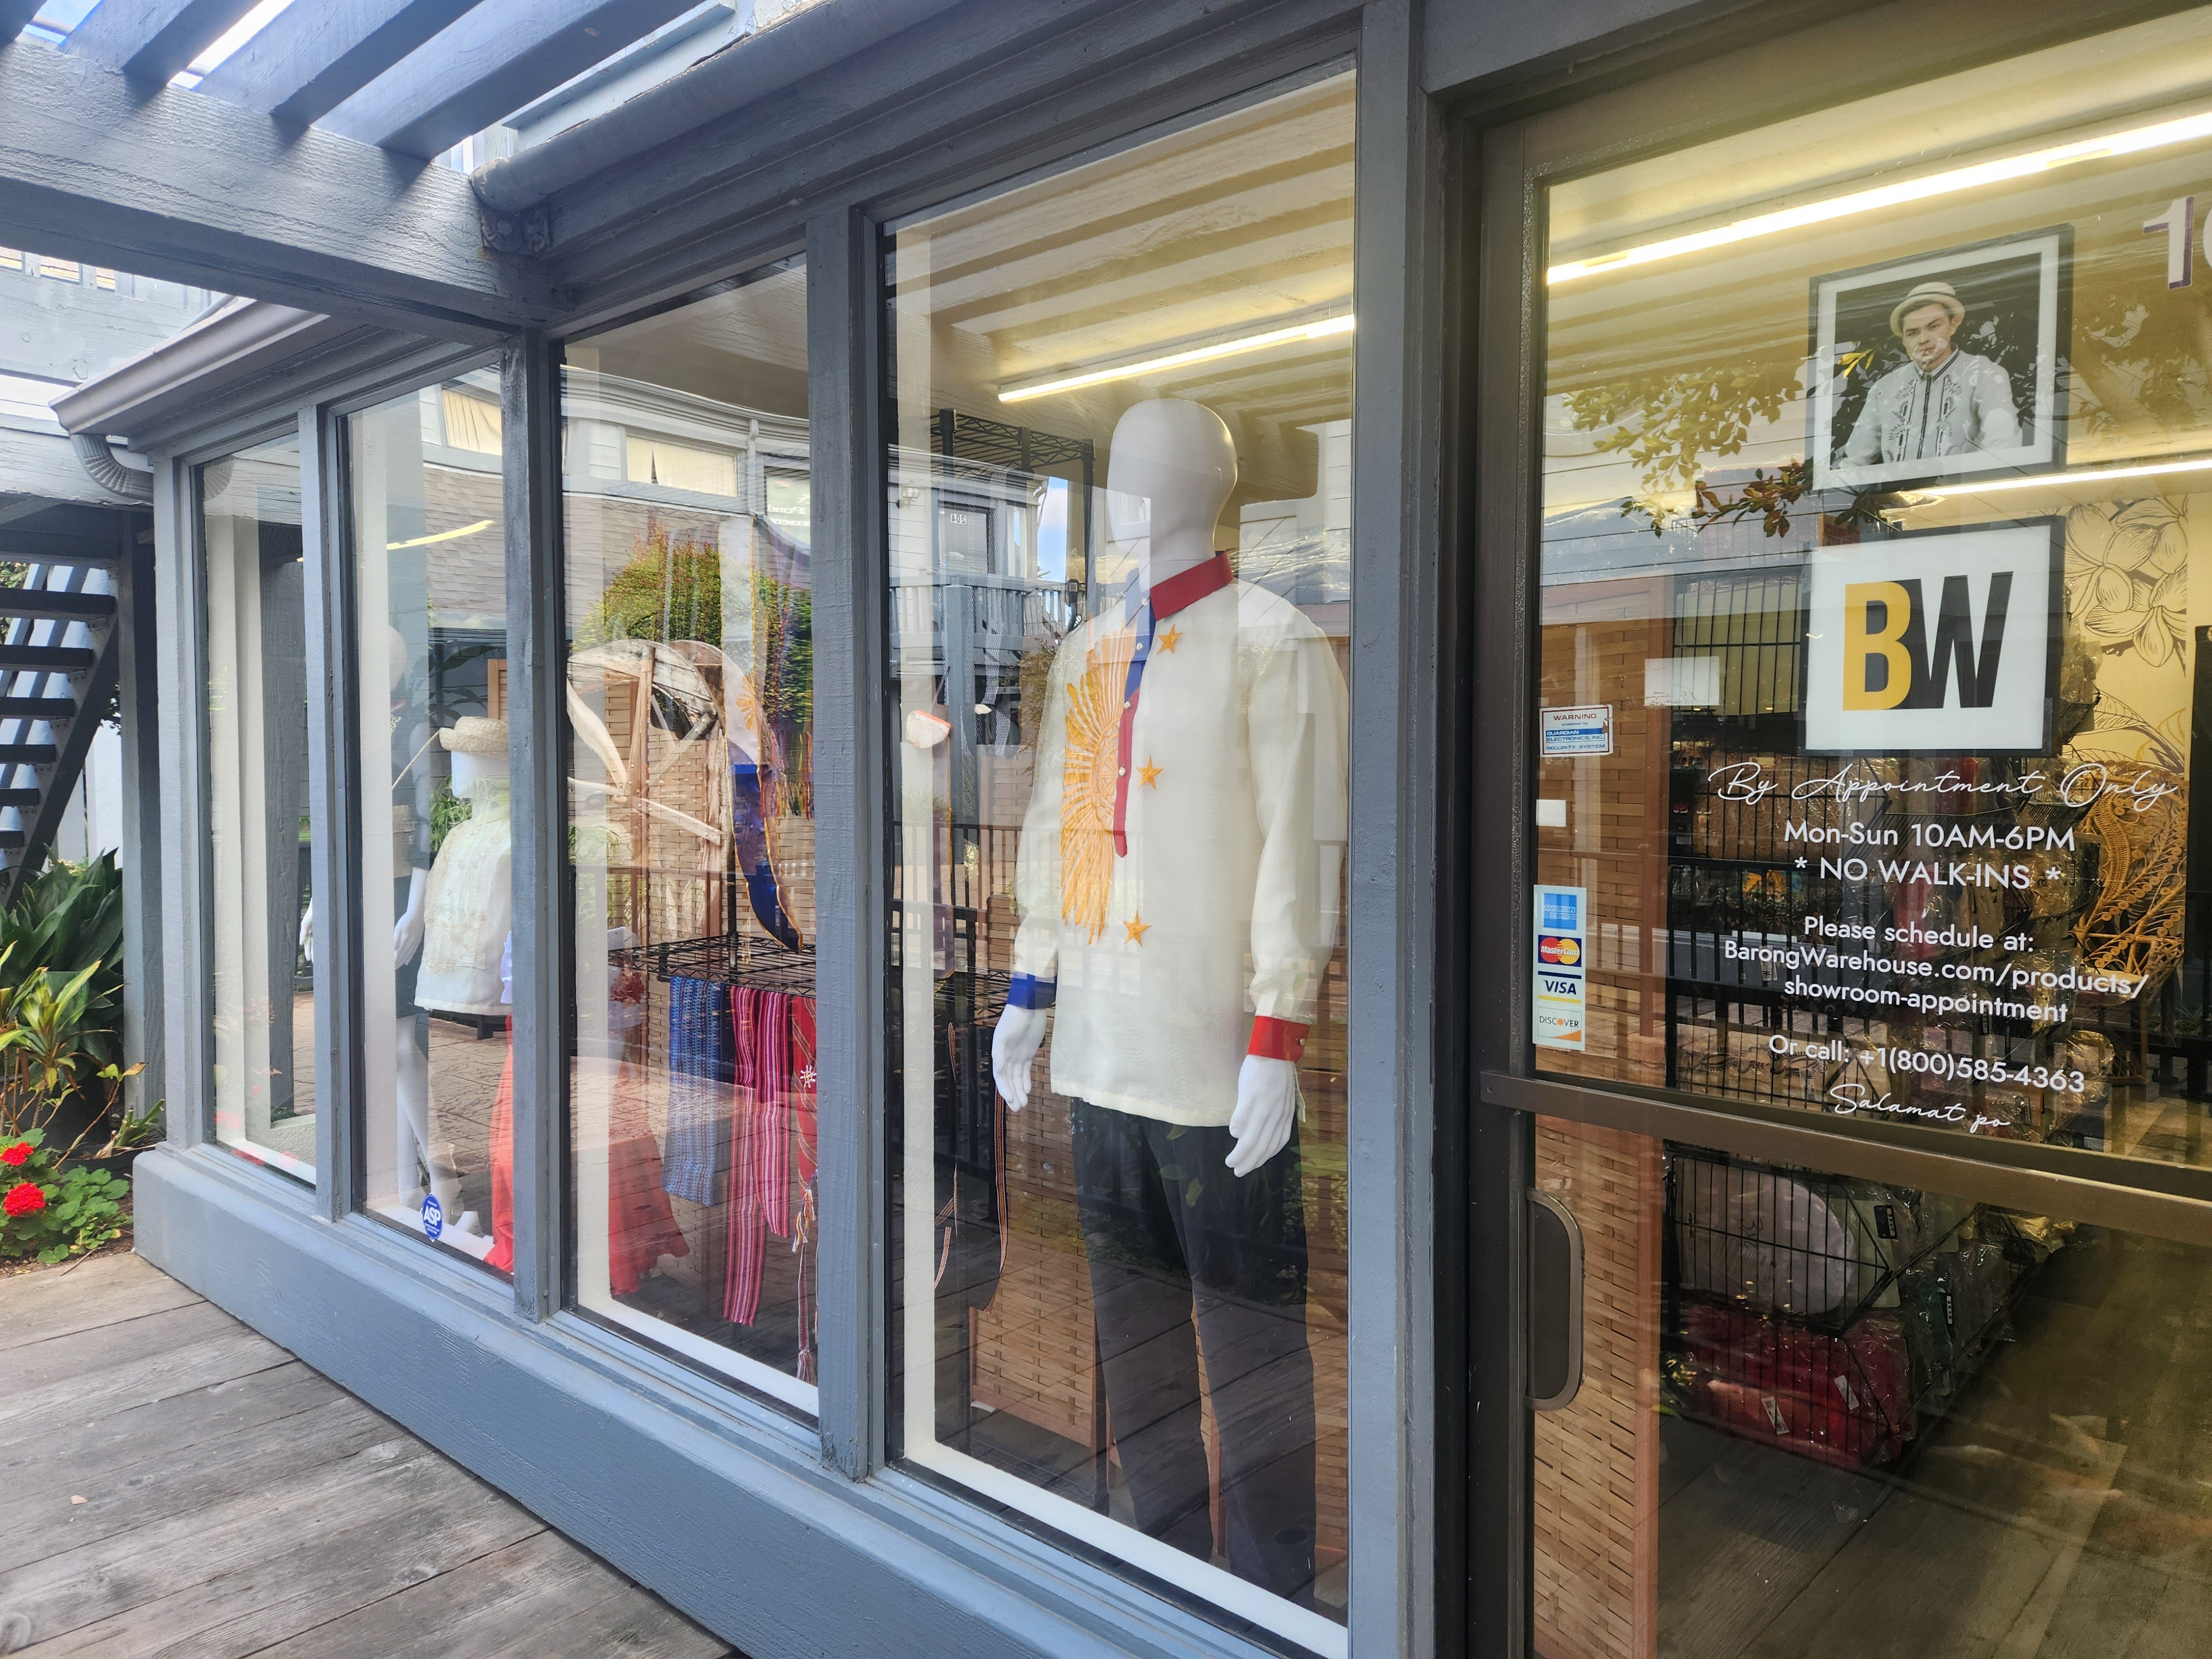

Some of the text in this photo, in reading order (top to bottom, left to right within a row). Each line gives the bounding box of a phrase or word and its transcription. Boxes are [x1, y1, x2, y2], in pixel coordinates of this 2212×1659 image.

[2143, 196, 2212, 290] 1
[1843, 571, 2013, 712] BW
[1708, 762, 1778, 805] By
[1791, 763, 2046, 803] Appointment
[2060, 763, 2178, 812] Only
[1784, 820, 2075, 852] Mon-Sun 10AM-6PM
[1820, 857, 1868, 881] NO
[1877, 859, 2029, 890] WALK-INS
[1540, 946, 1579, 956] MasterCard
[1804, 915, 2034, 952] Please schedule at:
[1542, 980, 1577, 995] VISA
[1724, 940, 2150, 999] BarongWarehouse.com/products/
[1784, 974, 2068, 1022] showroom-appointment
[1539, 1016, 1579, 1028] DISCOVER
[1768, 1034, 2085, 1093] Or call: +1(800)585-4363
[1829, 1083, 2011, 1134] Salamat po
[423, 1205, 441, 1226] ASP
